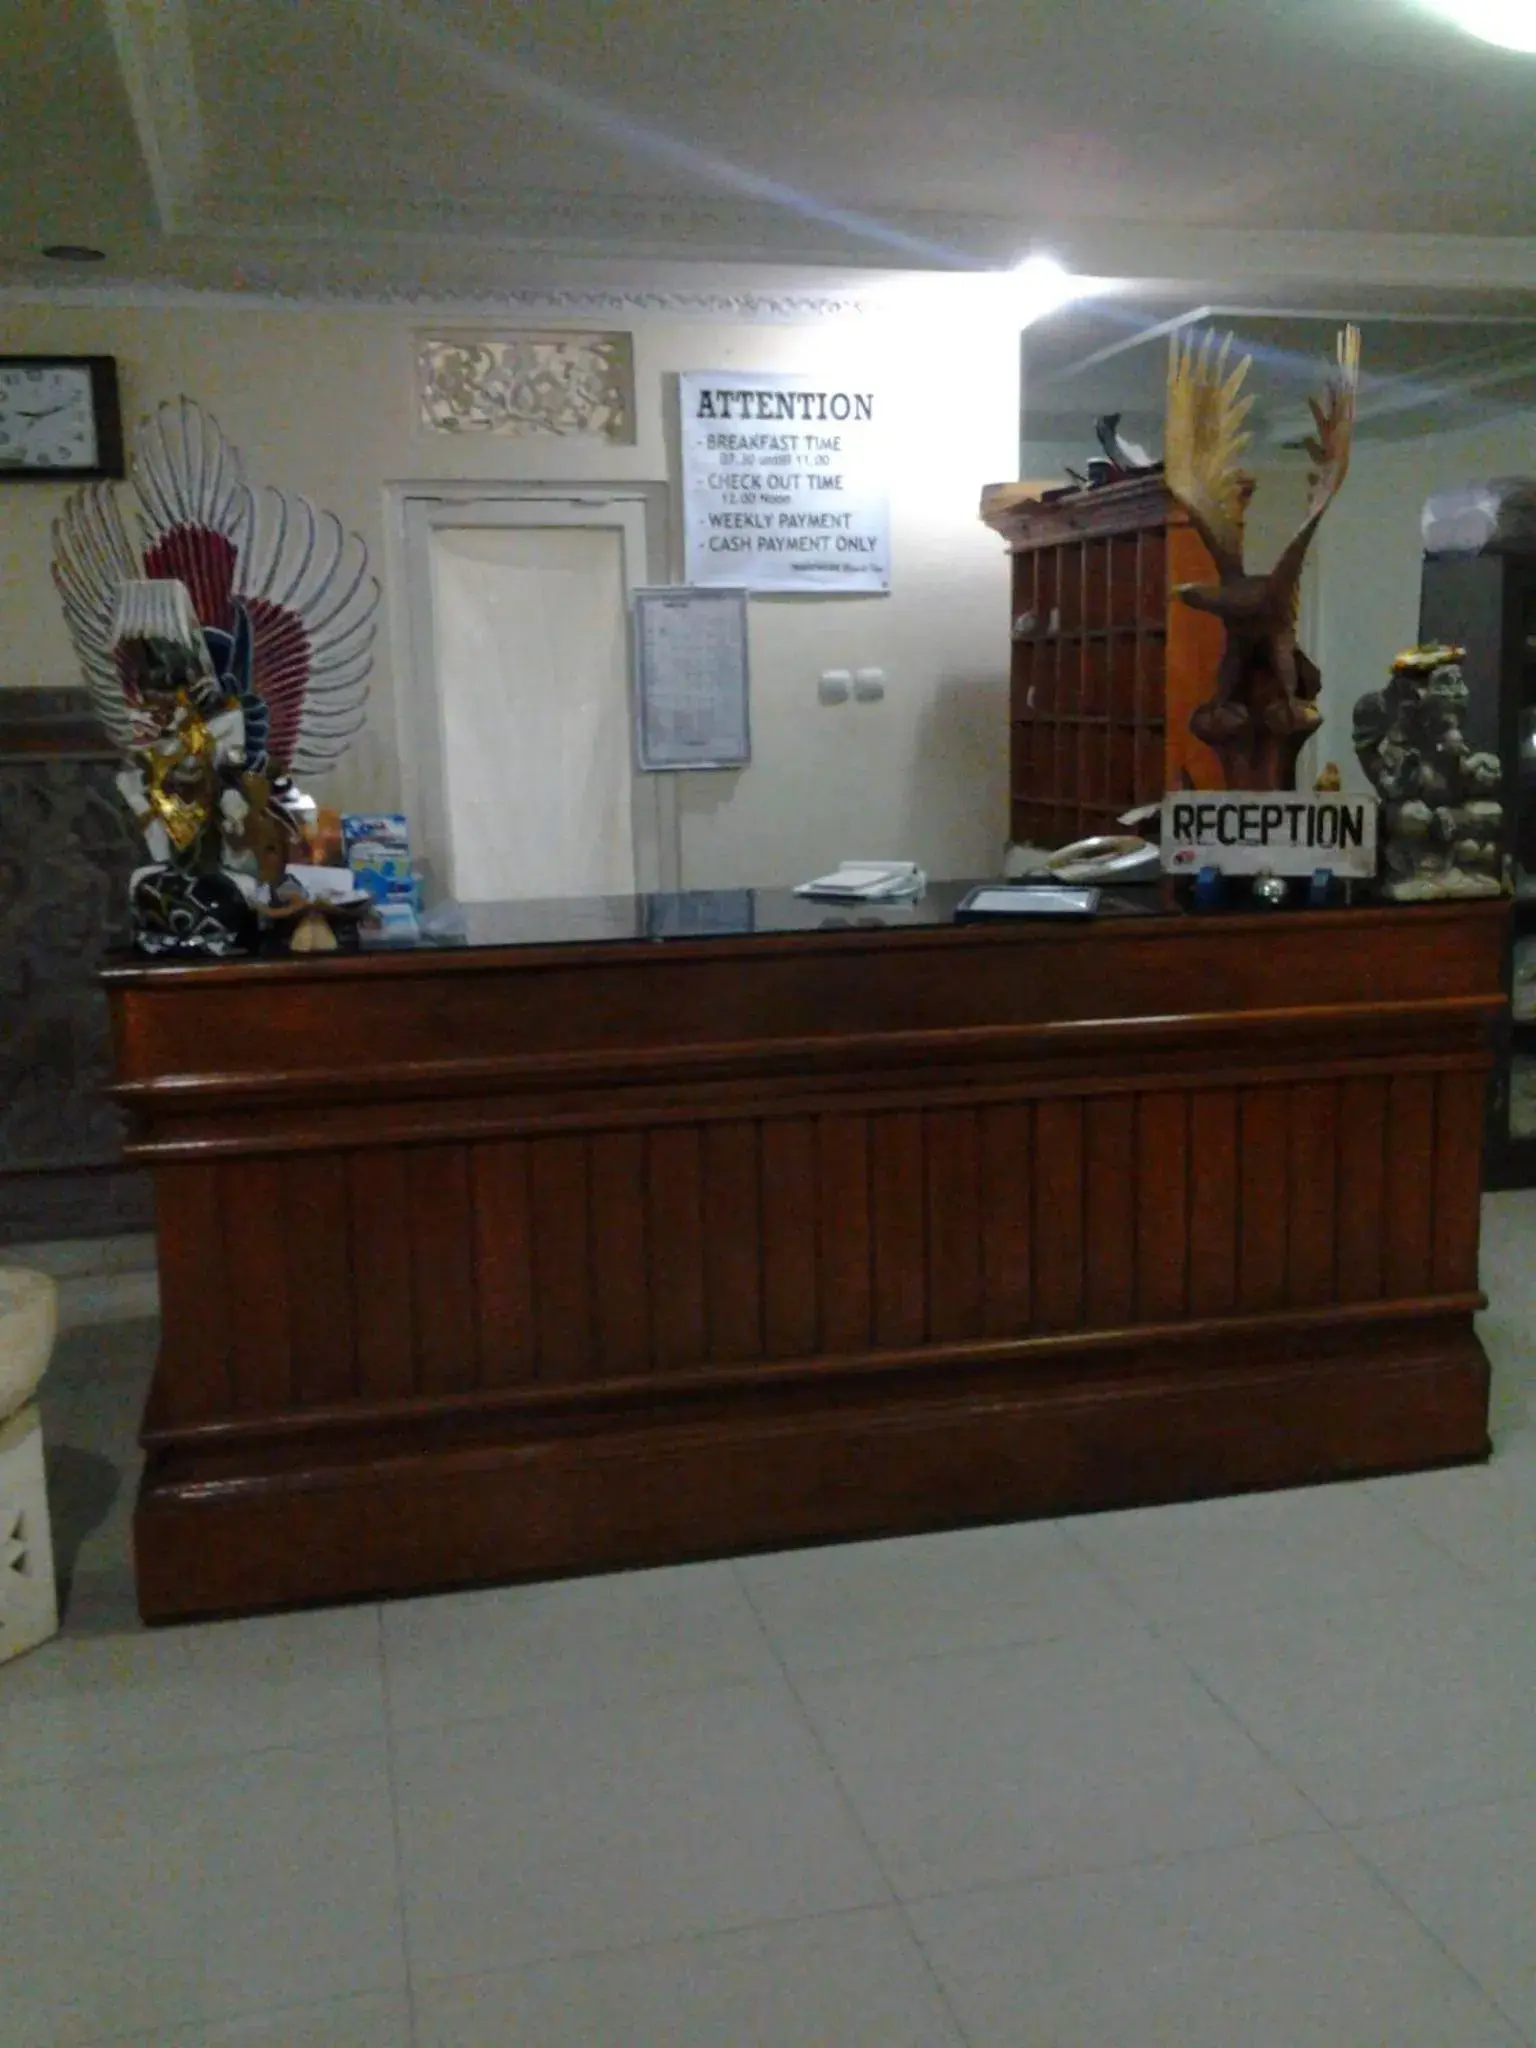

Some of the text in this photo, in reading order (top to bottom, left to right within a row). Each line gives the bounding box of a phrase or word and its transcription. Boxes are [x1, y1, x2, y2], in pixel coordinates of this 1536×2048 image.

[697, 390, 874, 420] ATTENTION
[707, 434, 841, 451] BREAKFAST TIME
[707, 473, 844, 490] CHECK OUT TIME
[708, 513, 852, 529] WEEKLY PAYMENT
[709, 536, 877, 552] CASH PAYMENT ONLY
[1173, 804, 1364, 849] RECEPTION
